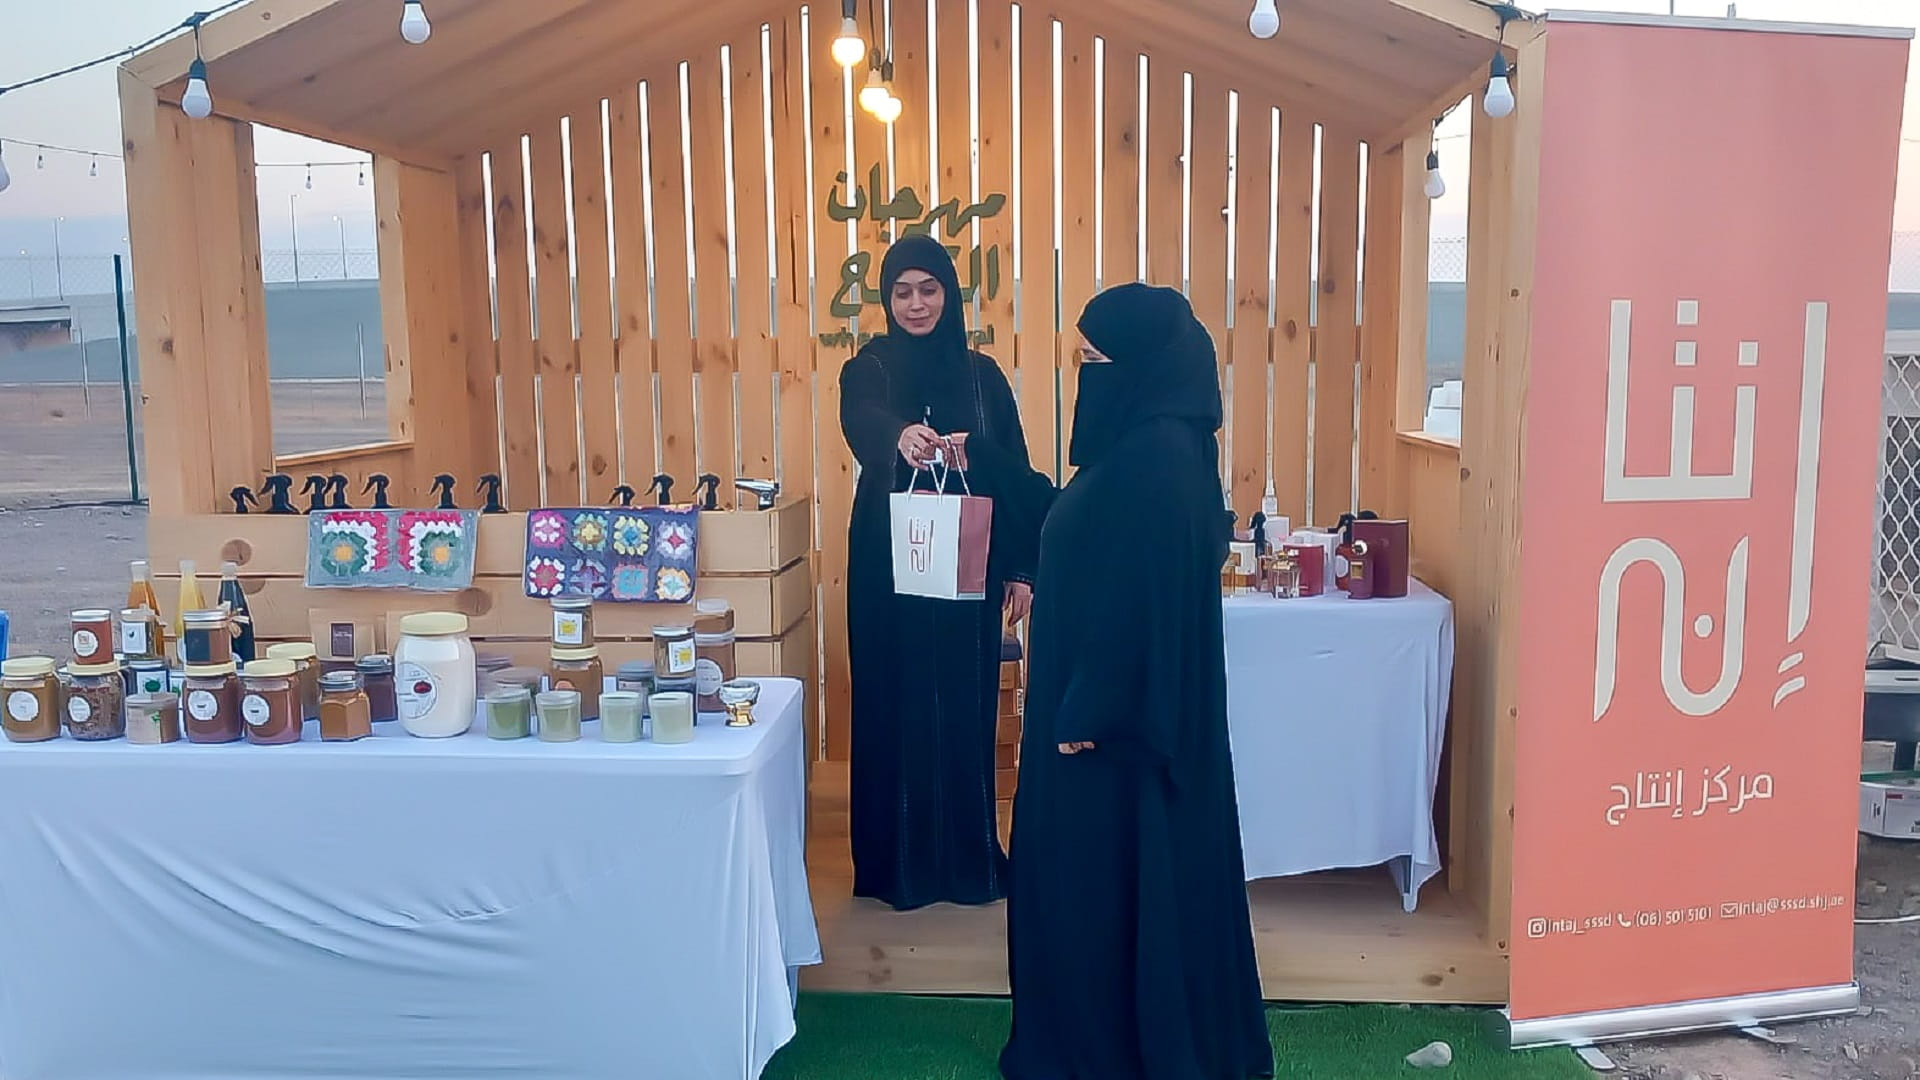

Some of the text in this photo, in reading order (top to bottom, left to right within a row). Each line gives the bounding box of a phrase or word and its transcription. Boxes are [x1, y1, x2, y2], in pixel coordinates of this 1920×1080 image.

[1605, 764, 1774, 826] مركز إنتاج
[1636, 906, 1712, 928] (06) 501 5101
